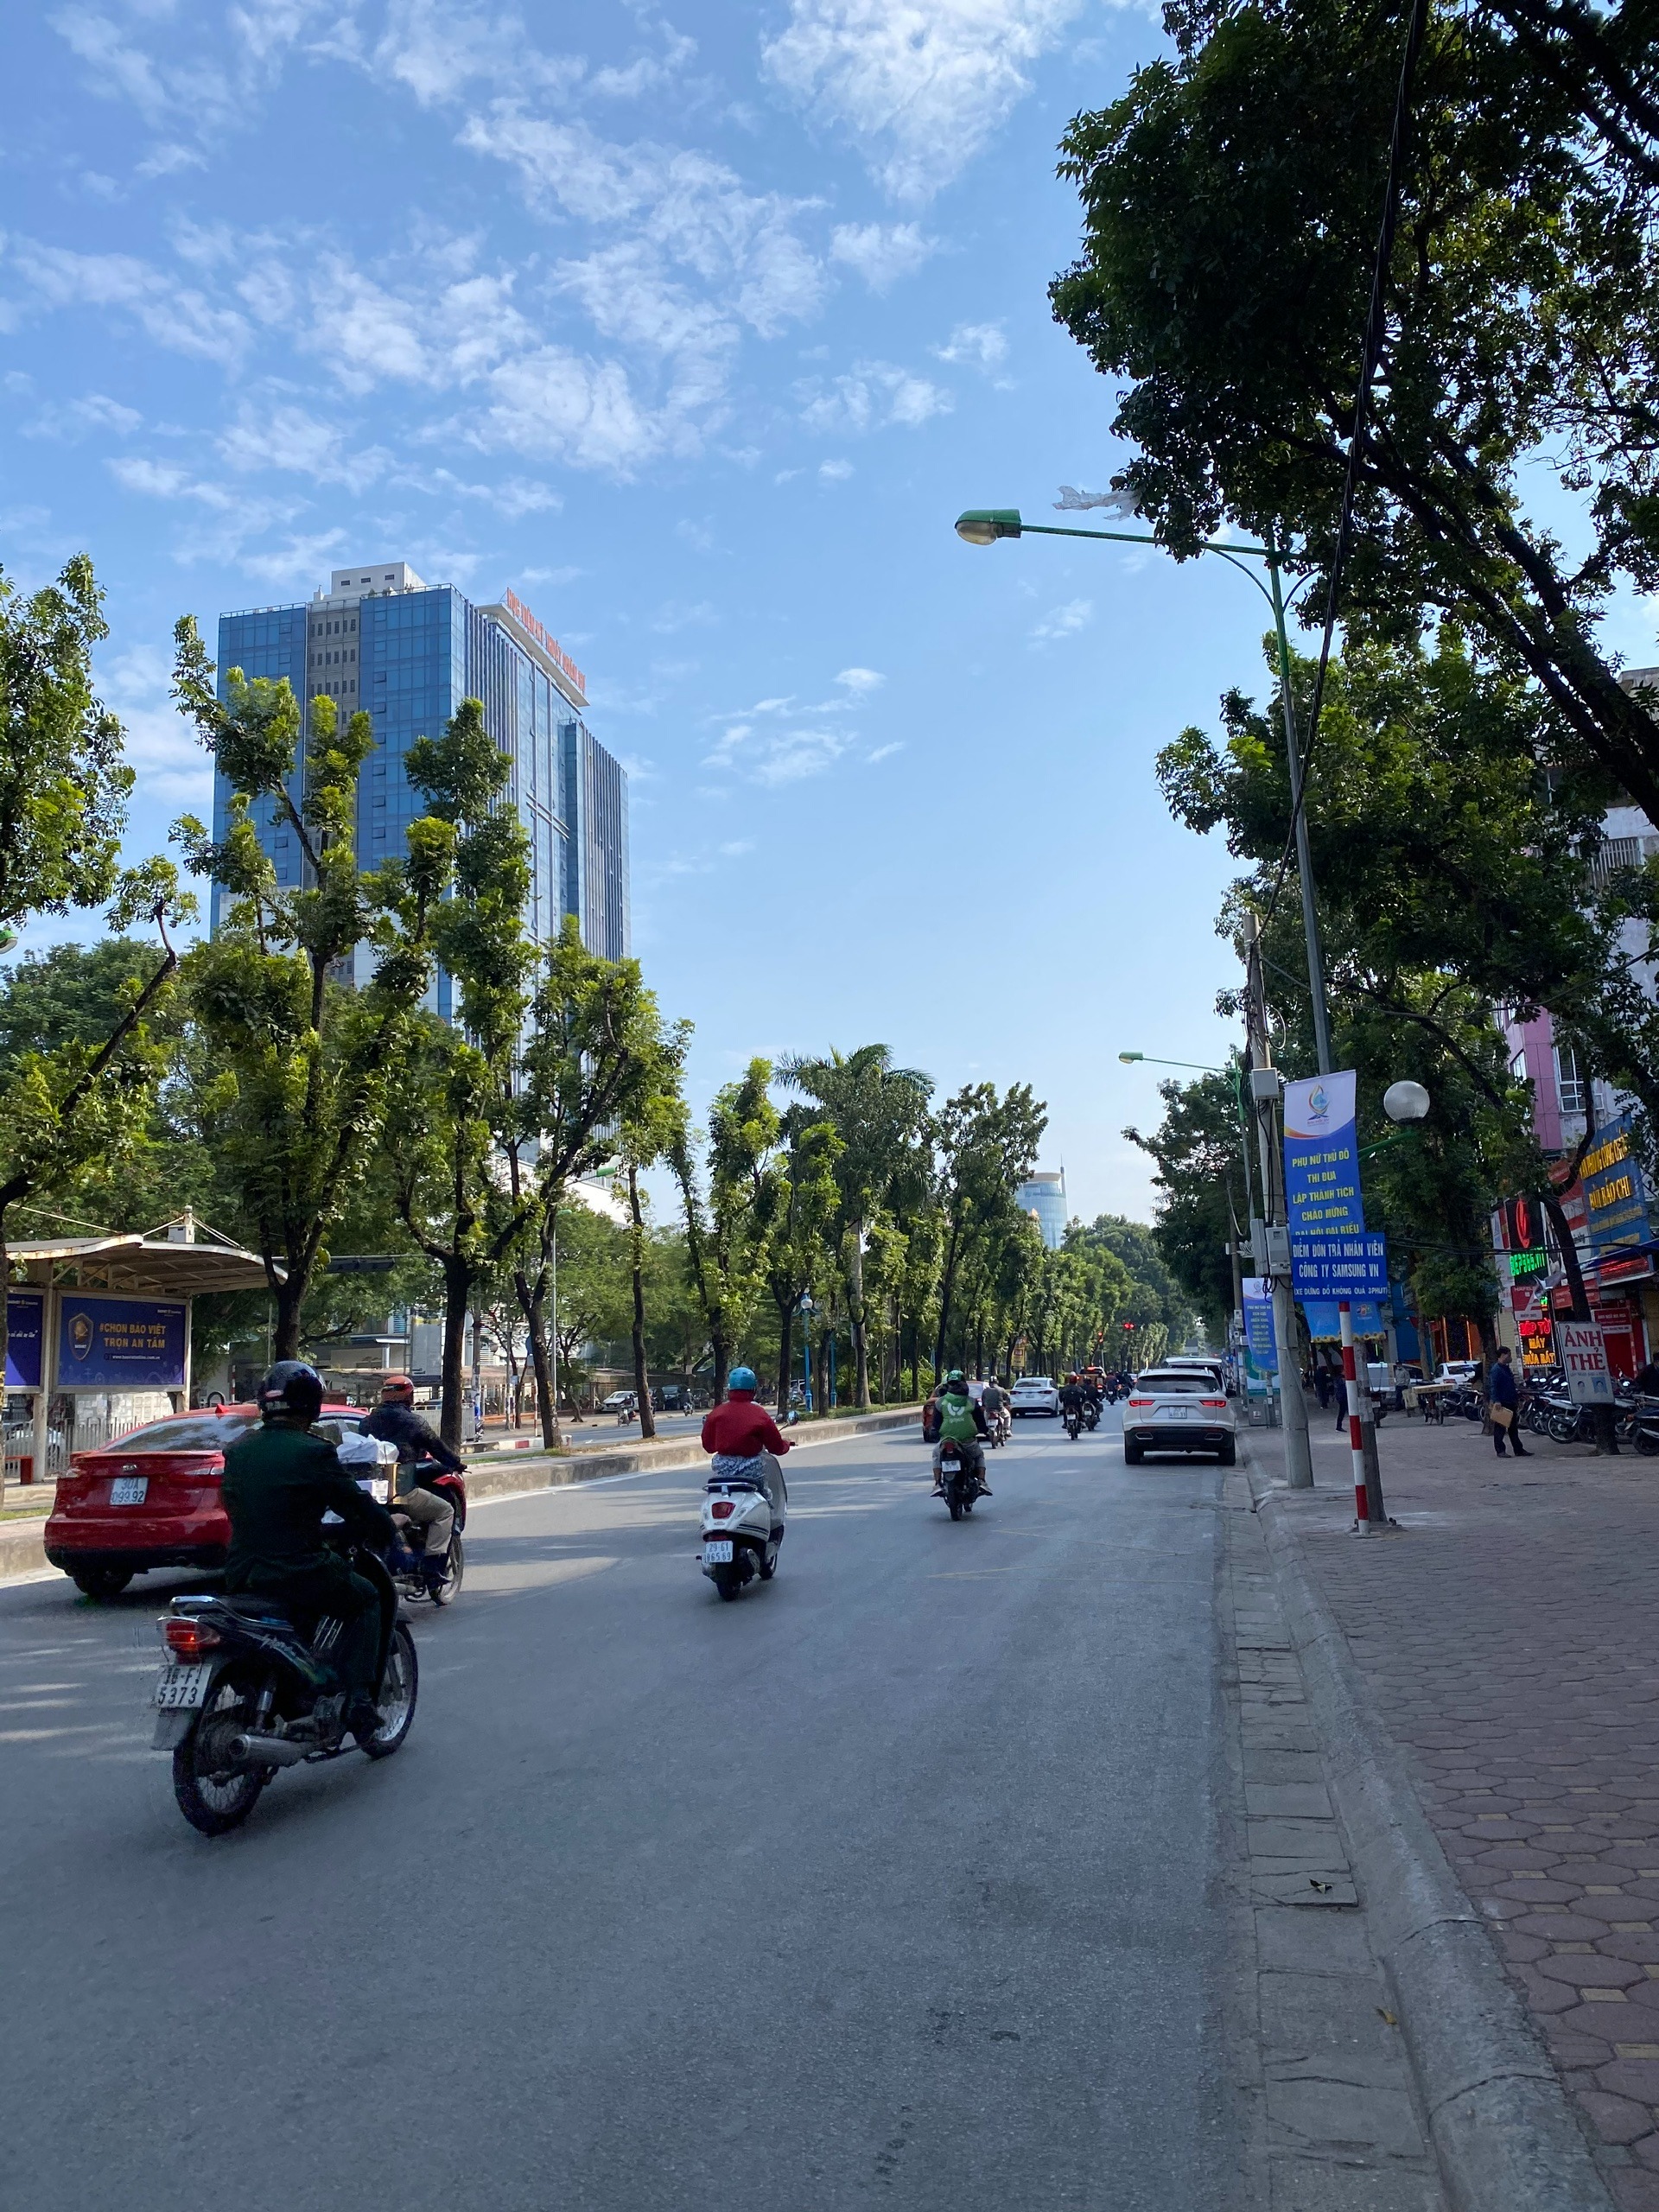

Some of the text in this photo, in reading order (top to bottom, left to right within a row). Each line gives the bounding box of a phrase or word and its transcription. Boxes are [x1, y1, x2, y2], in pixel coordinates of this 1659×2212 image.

[1292, 1147, 1350, 1168] PHỤ NỮ THỦ ĐÔ
[1307, 1171, 1337, 1184] THI ĐUA
[1293, 1185, 1355, 1205] LẬP THÀNH TÍCH
[1301, 1205, 1349, 1222] CHÀO MỪNG
[1340, 1221, 1359, 1234] BIỂU
[1293, 1237, 1383, 1257] ĐIỂM ĐÓN TRẢ NHÂN VIÊN
[1299, 1262, 1379, 1278] CÔNG TY SAMSUNG VN
[1332, 1285, 1351, 1295] KHÔNG
[129, 1321, 146, 1334] BẢO
[148, 1323, 166, 1337] VIỆT
[1564, 1325, 1603, 1347] ẢNH
[104, 1337, 165, 1350] TRỌN AN TÂM
[1567, 1347, 1605, 1370] THẺ
[121, 1478, 138, 1491] 30A
